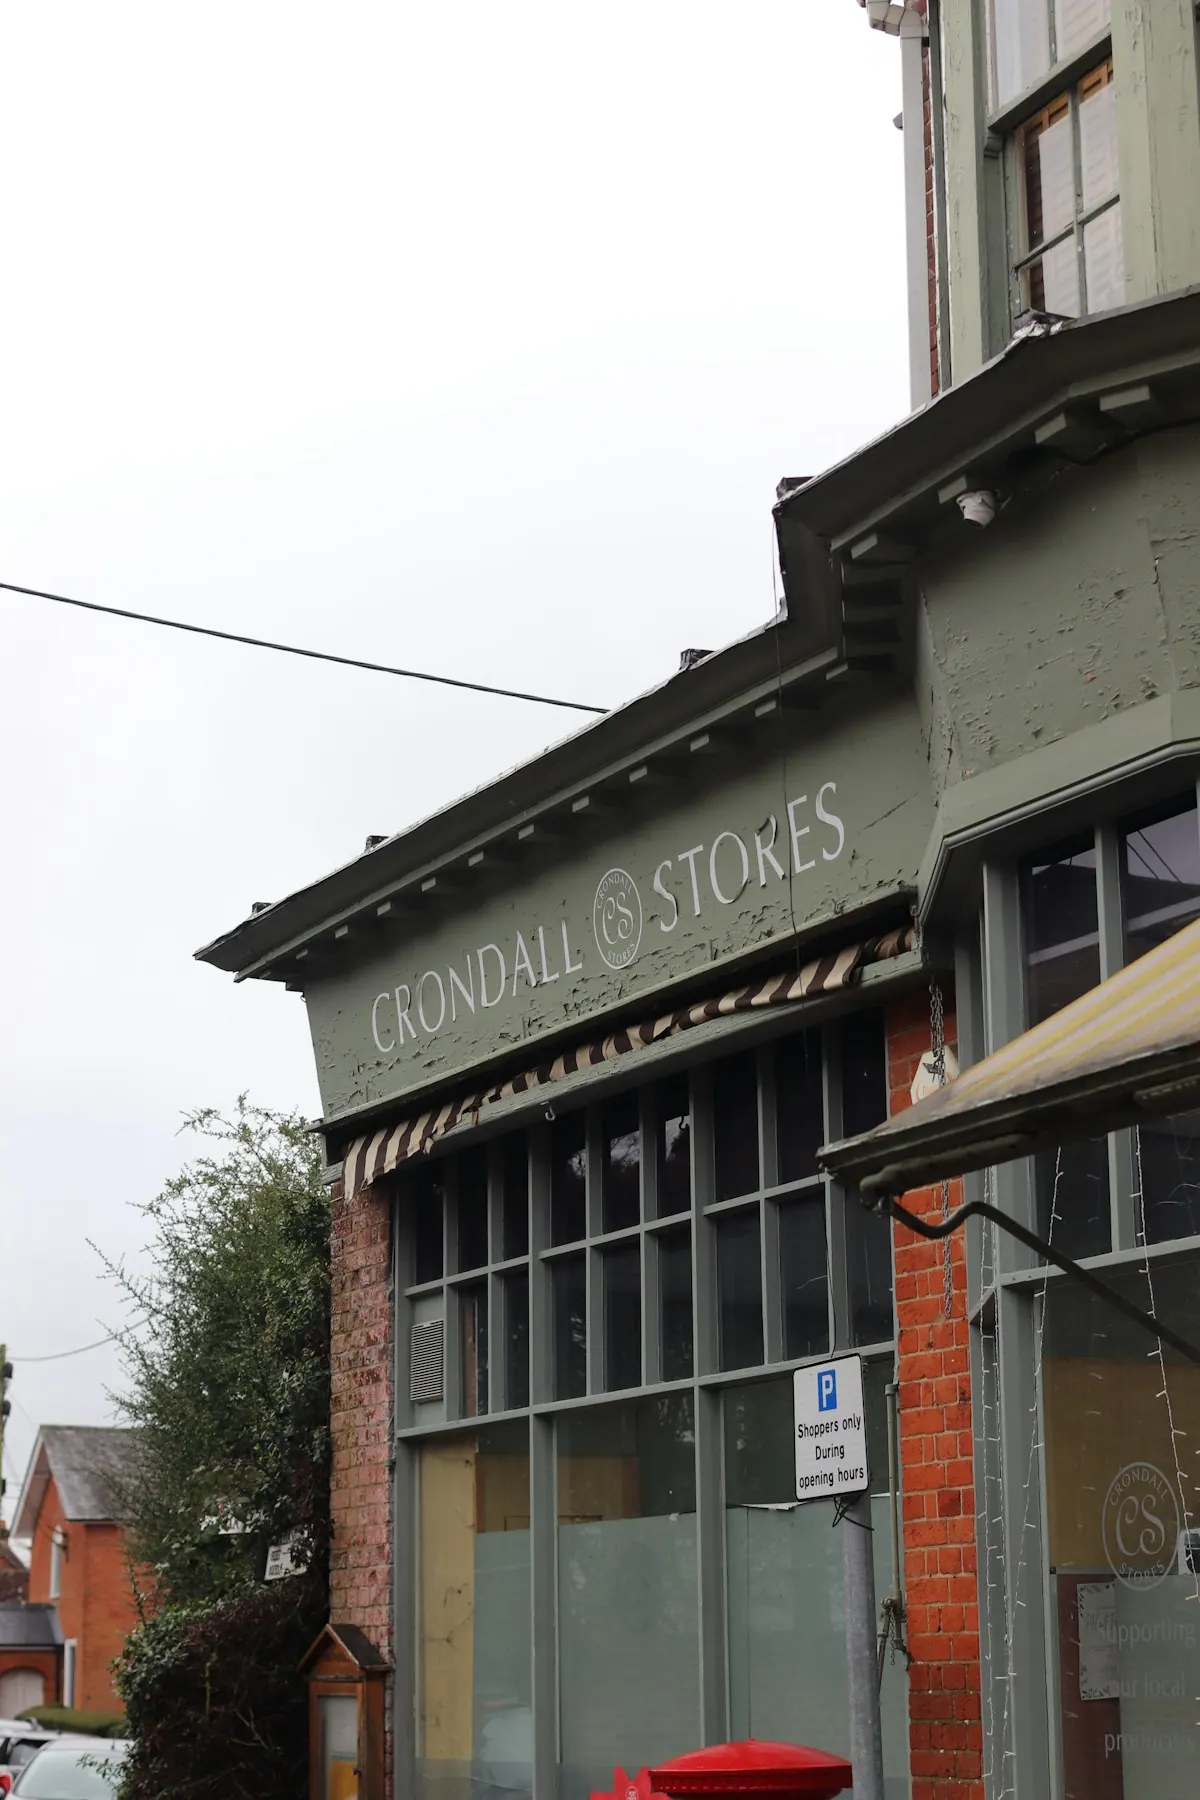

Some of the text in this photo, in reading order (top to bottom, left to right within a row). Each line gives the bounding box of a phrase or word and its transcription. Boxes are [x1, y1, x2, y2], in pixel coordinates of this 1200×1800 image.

[597, 873, 632, 909] CRONDALL
[371, 782, 846, 1053] CRONDALL STORES
[607, 942, 635, 964] STORES
[822, 1374, 834, 1408] P
[798, 1413, 861, 1438] Shoppers only
[815, 1443, 845, 1460] During
[799, 1467, 864, 1489] opening hours
[1110, 1468, 1168, 1506] CRONDALL
[1119, 1559, 1165, 1583] STORES
[1109, 1671, 1186, 1697] our local
